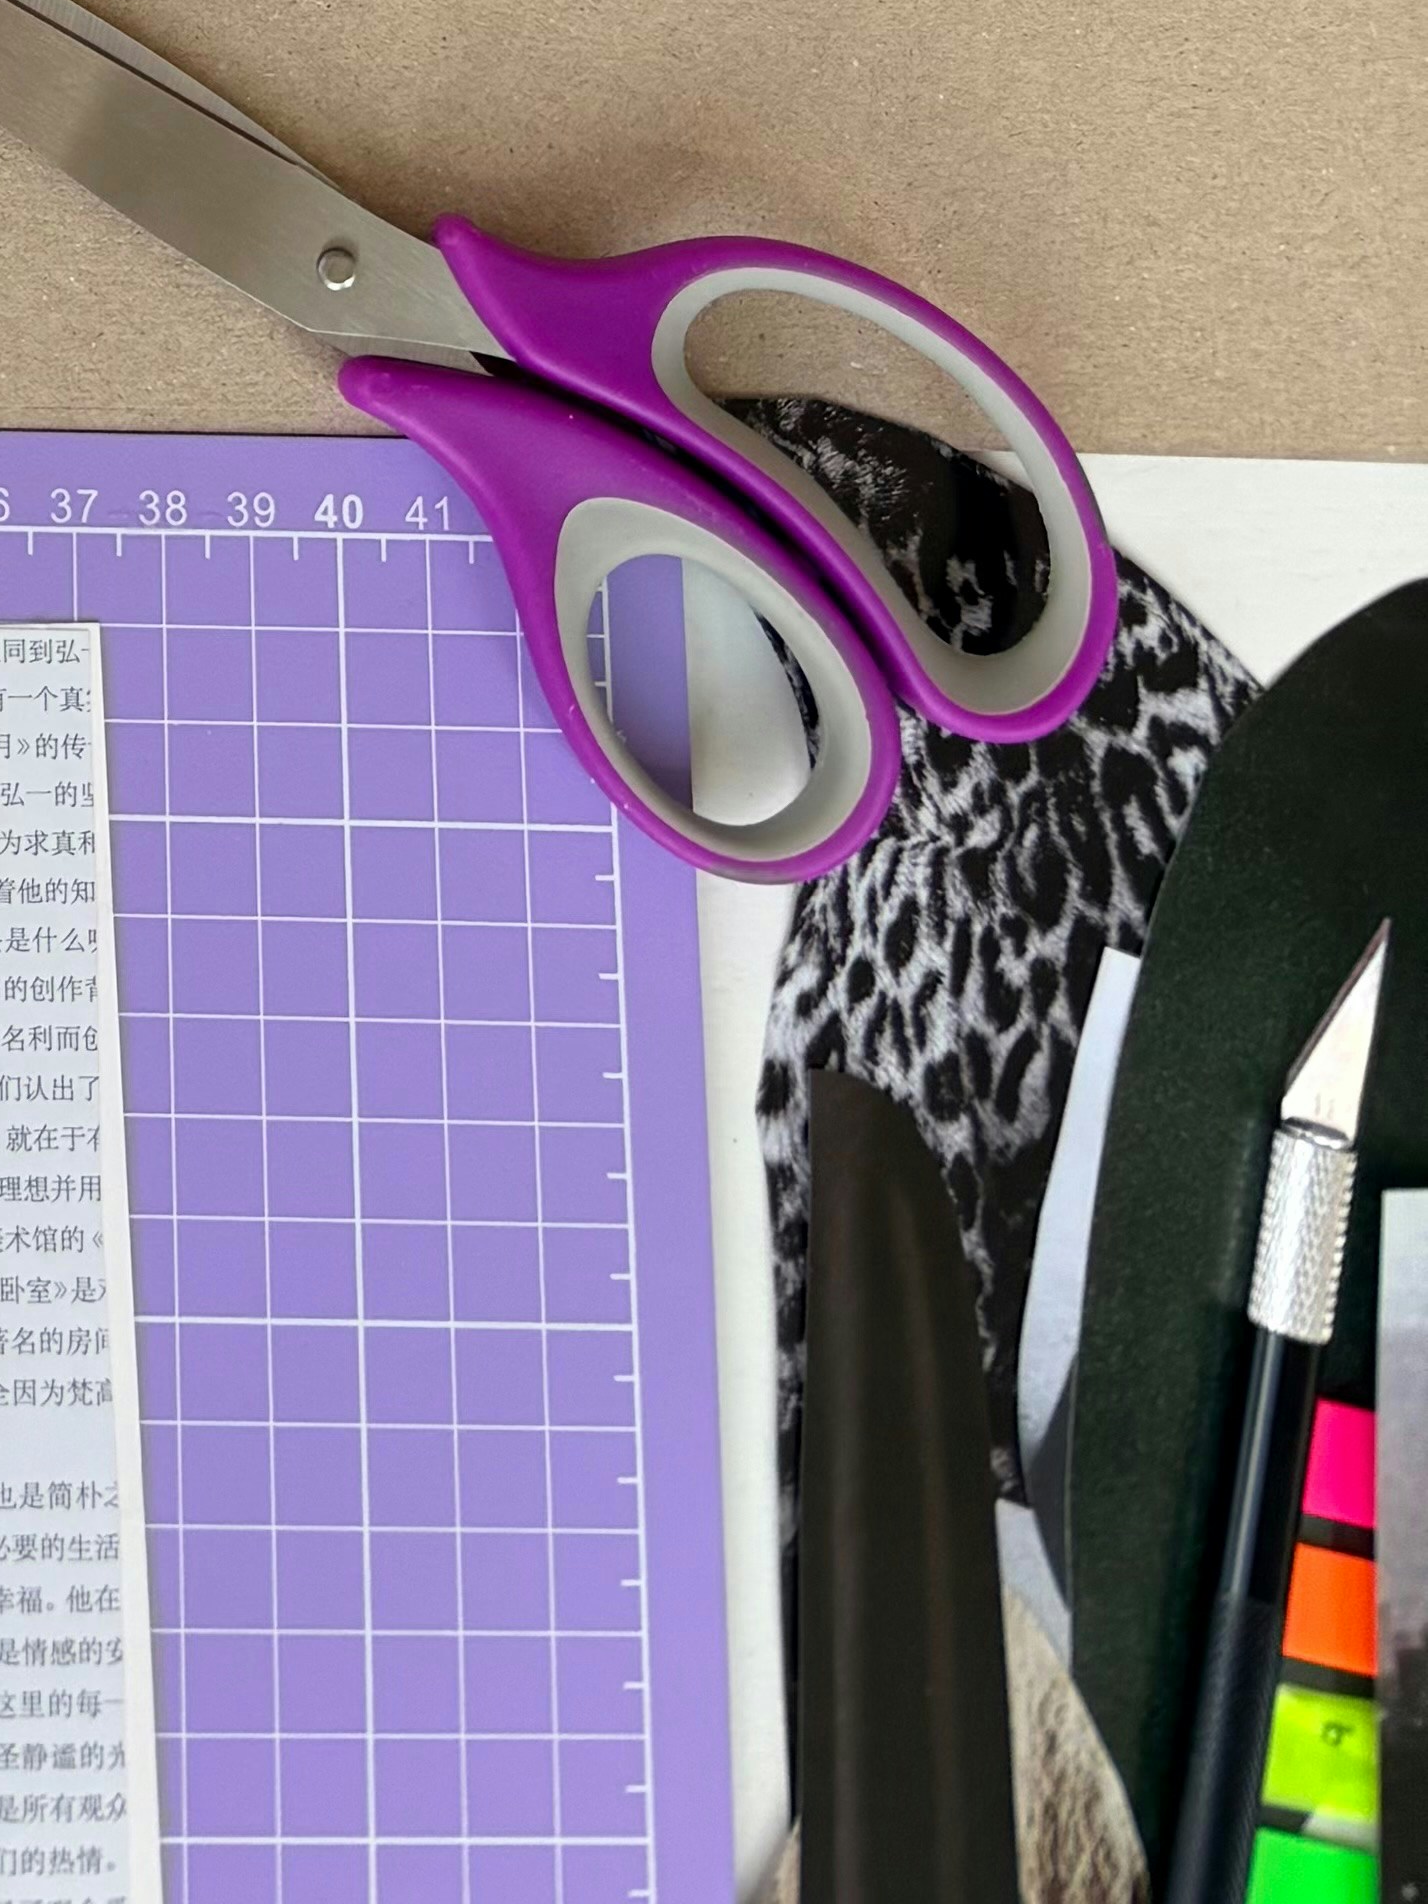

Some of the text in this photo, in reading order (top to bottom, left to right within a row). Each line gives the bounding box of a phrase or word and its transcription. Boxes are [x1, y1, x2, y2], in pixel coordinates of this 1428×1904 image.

[50, 487, 99, 525] 37
[137, 489, 187, 527] 38
[227, 491, 276, 529] 39
[313, 493, 364, 530] 40
[405, 496, 448, 530] 41
